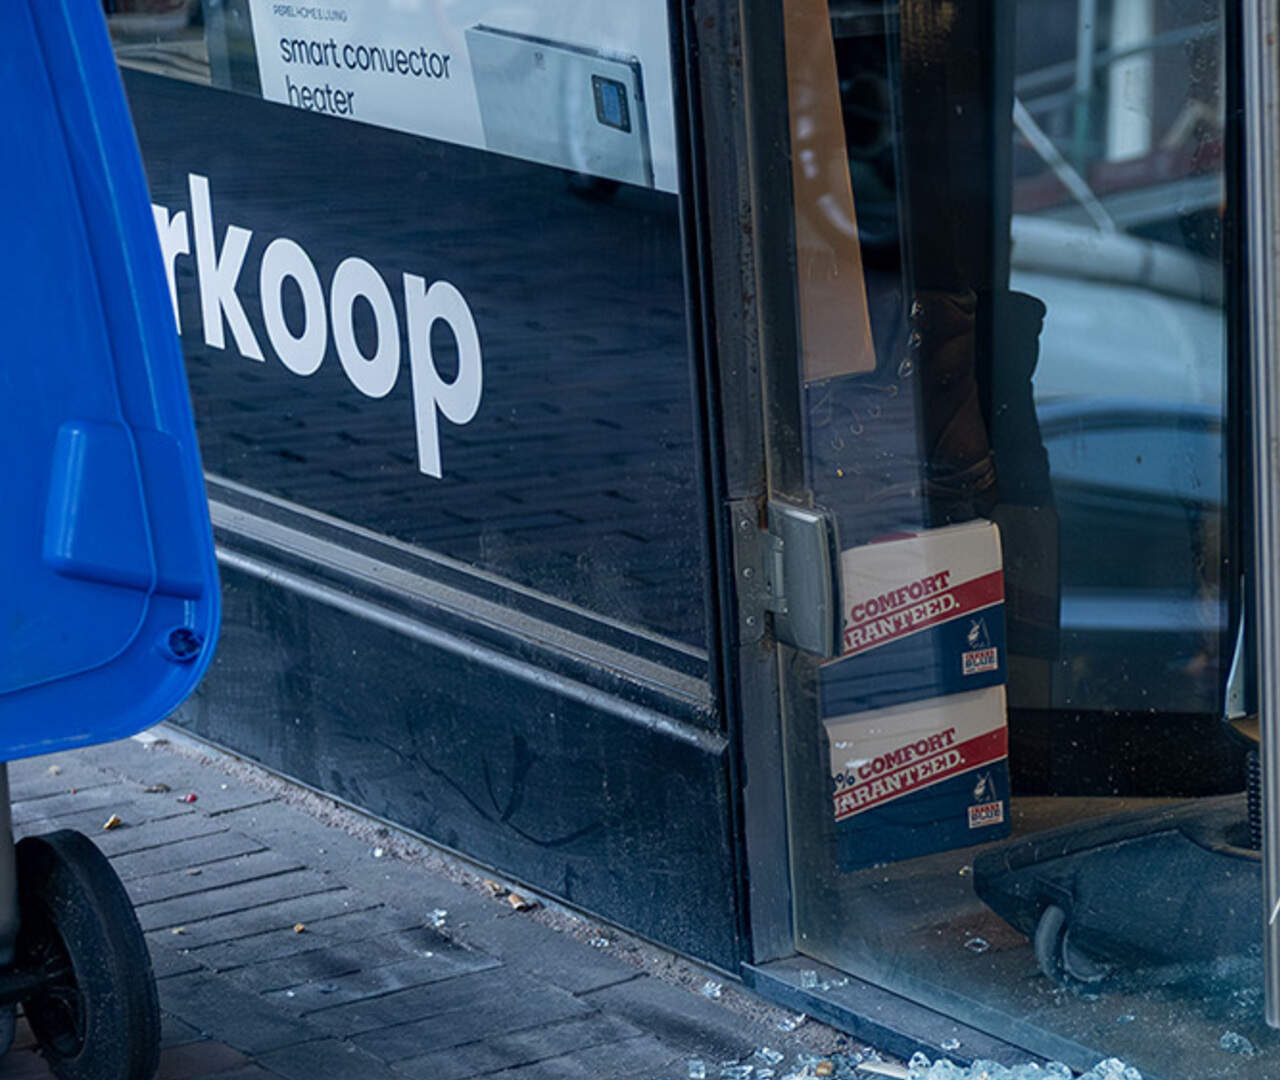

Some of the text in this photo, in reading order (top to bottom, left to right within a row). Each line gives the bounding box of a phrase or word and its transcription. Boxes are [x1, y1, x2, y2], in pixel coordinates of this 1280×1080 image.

[280, 38, 450, 79] smart convector
[286, 75, 354, 115] heater
[851, 570, 950, 622] COMFORT
[844, 593, 961, 652] RANTEED.
[858, 728, 956, 780] COMFORT
